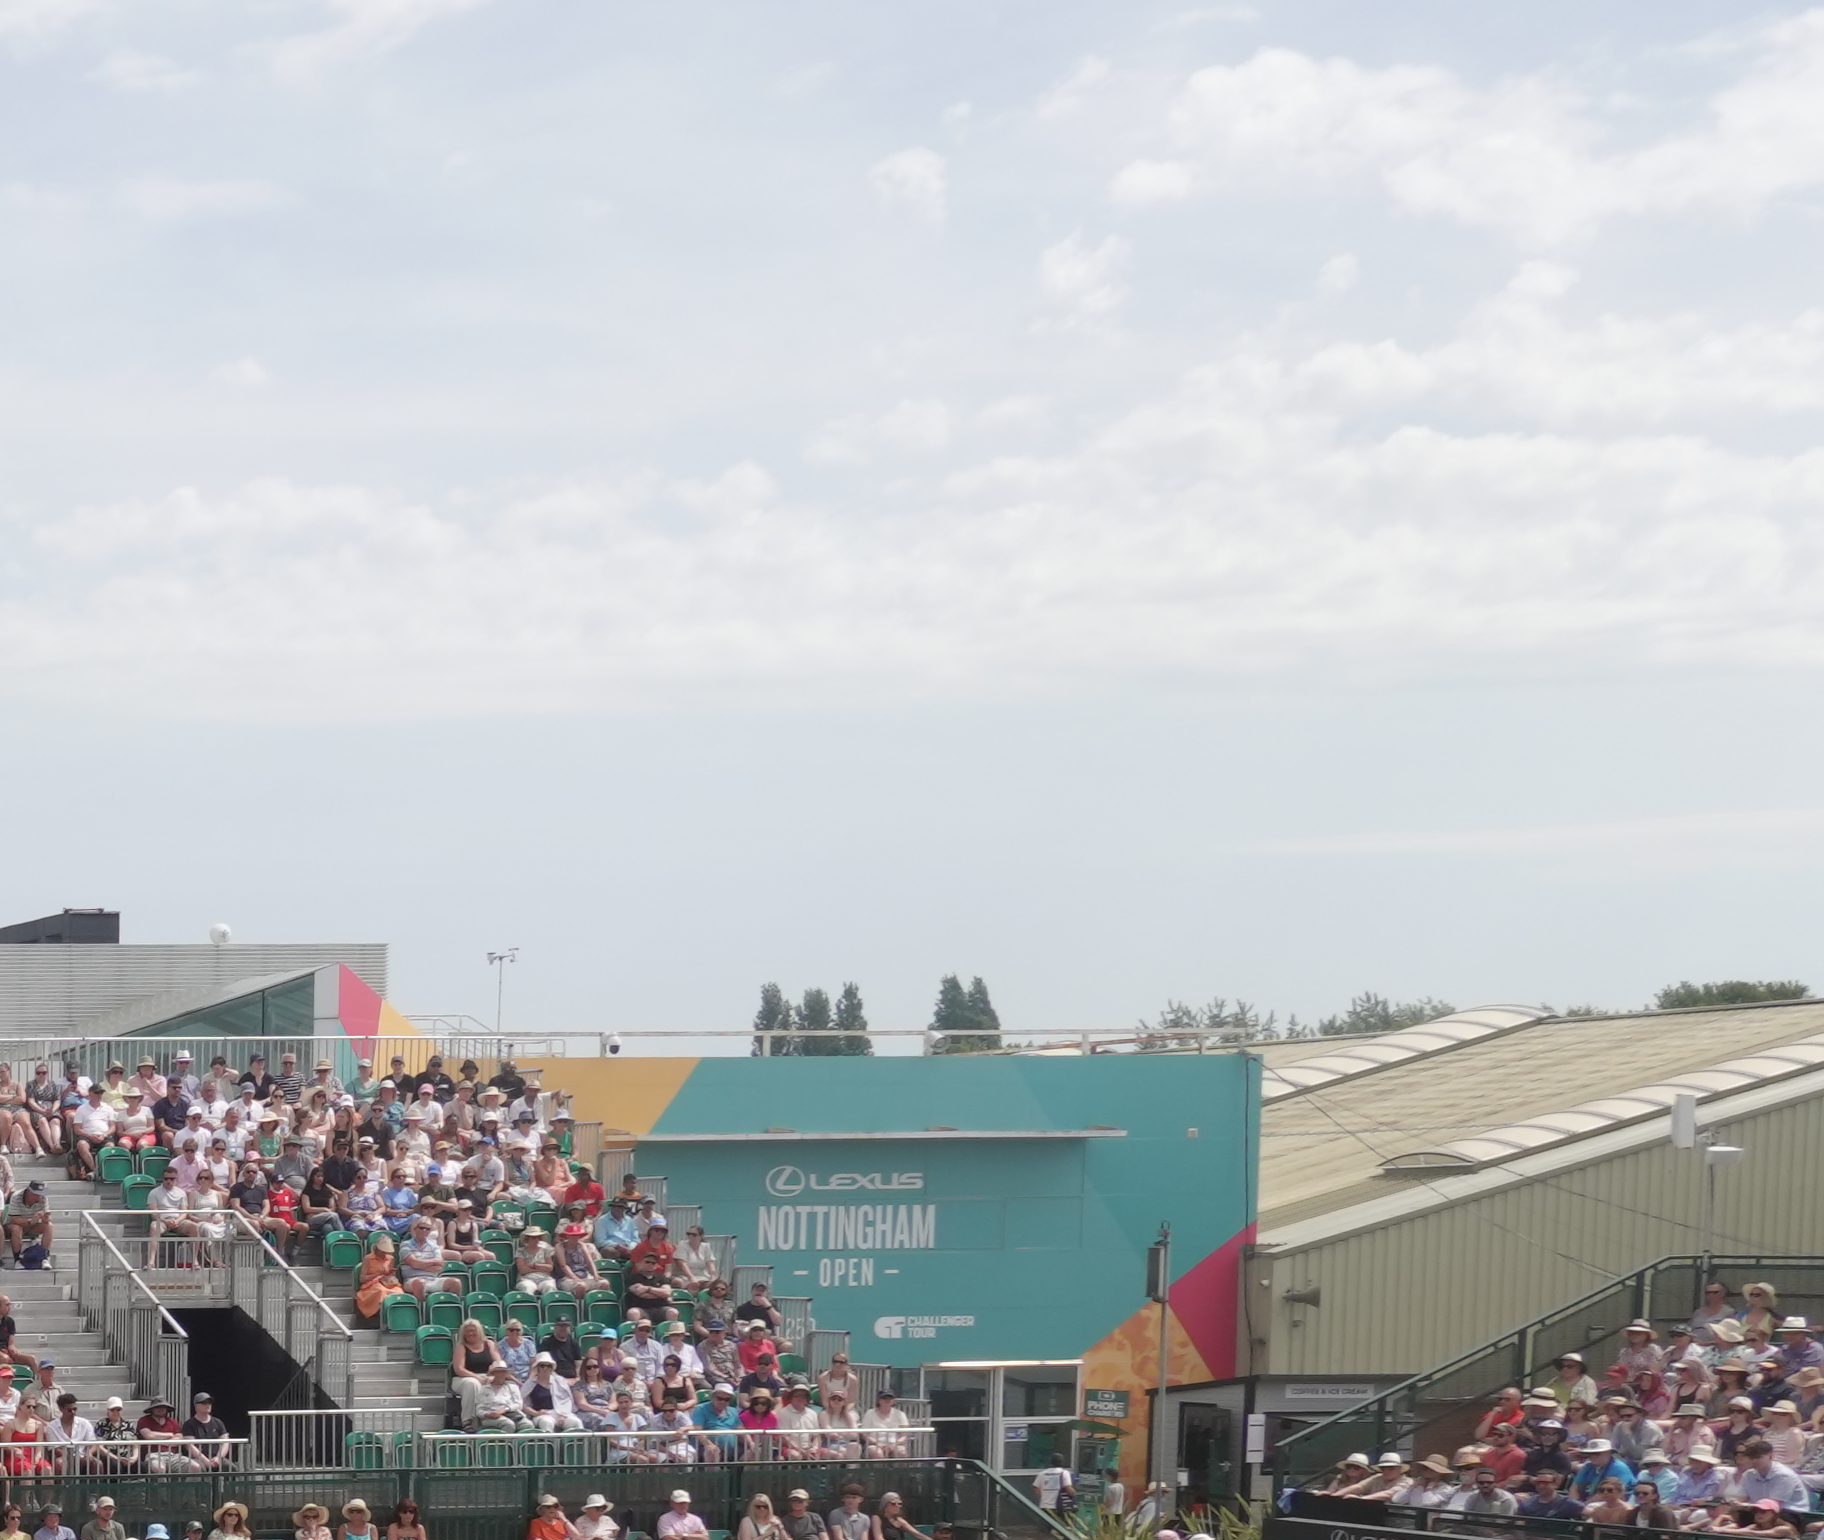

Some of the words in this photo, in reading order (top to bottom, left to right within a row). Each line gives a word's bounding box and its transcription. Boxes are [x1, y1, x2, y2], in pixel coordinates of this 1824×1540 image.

[810, 1172, 924, 1190] LEXUS
[758, 1205, 936, 1251] NOTTINGHAM
[819, 1258, 874, 1288] OPEN
[907, 1315, 975, 1327] CHALLENGER
[907, 1327, 937, 1339] TOUR
[1087, 1401, 1125, 1410] PHONE
